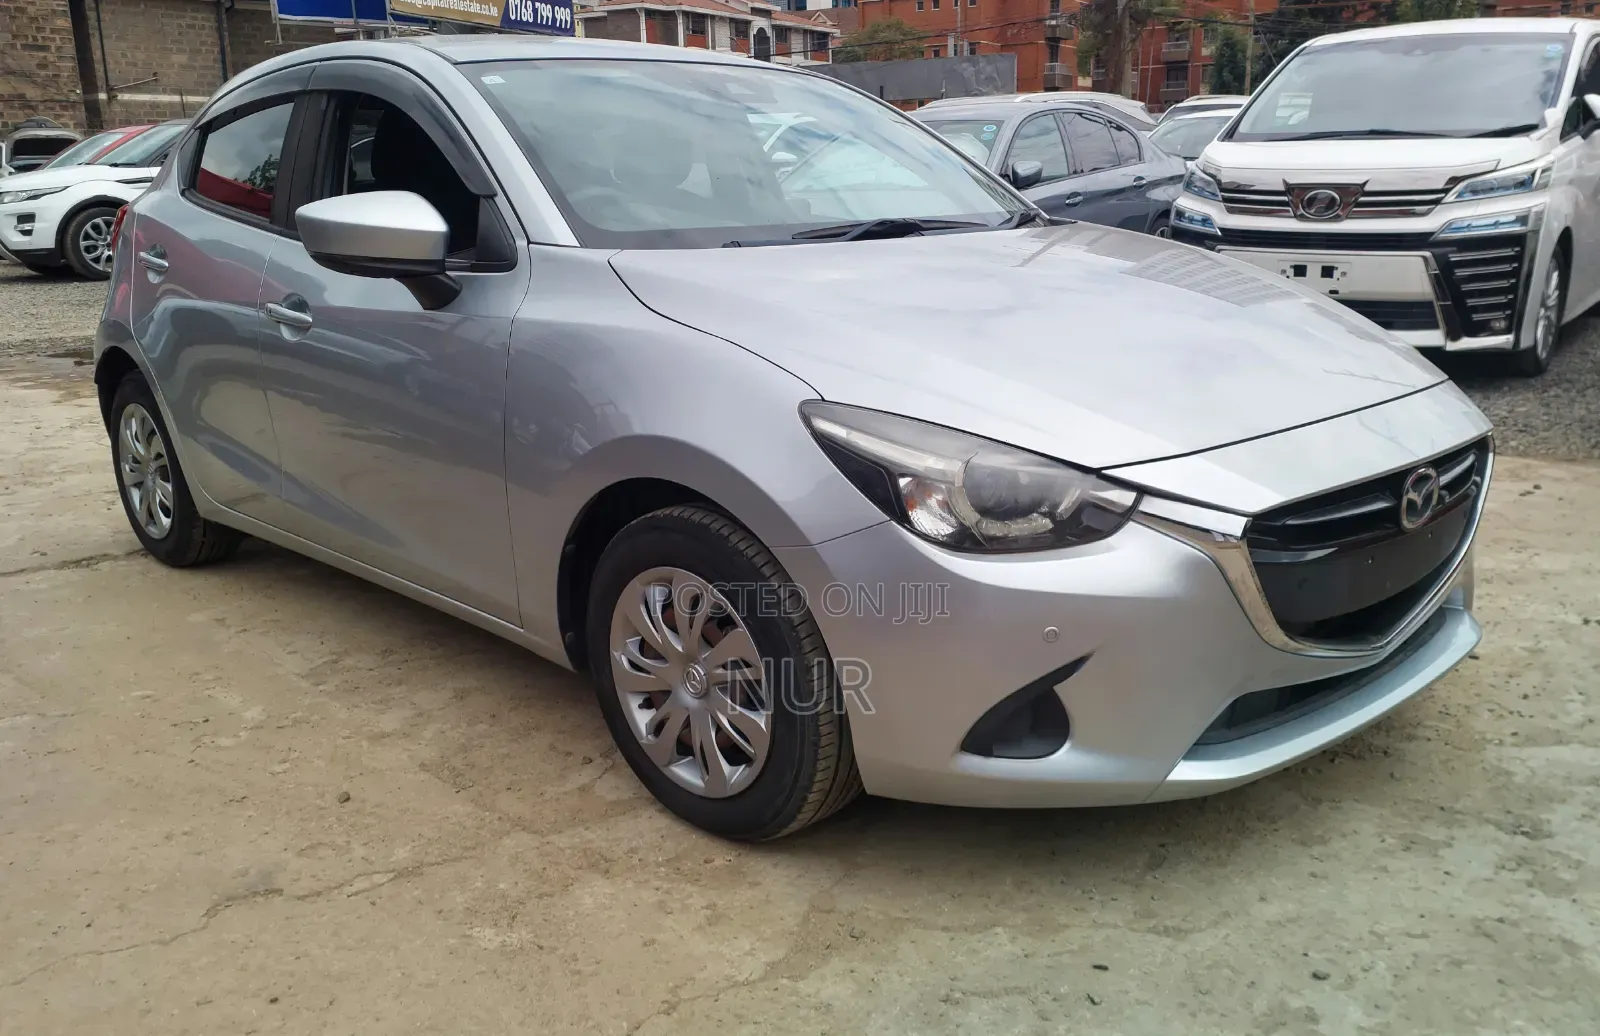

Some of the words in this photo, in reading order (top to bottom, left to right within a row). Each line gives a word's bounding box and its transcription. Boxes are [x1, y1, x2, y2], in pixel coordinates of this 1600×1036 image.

[400, 0, 498, 16] @capitalrealestate.co.ke
[509, 0, 533, 22] 0768
[535, 2, 552, 25] 799
[554, 6, 571, 28] 999
